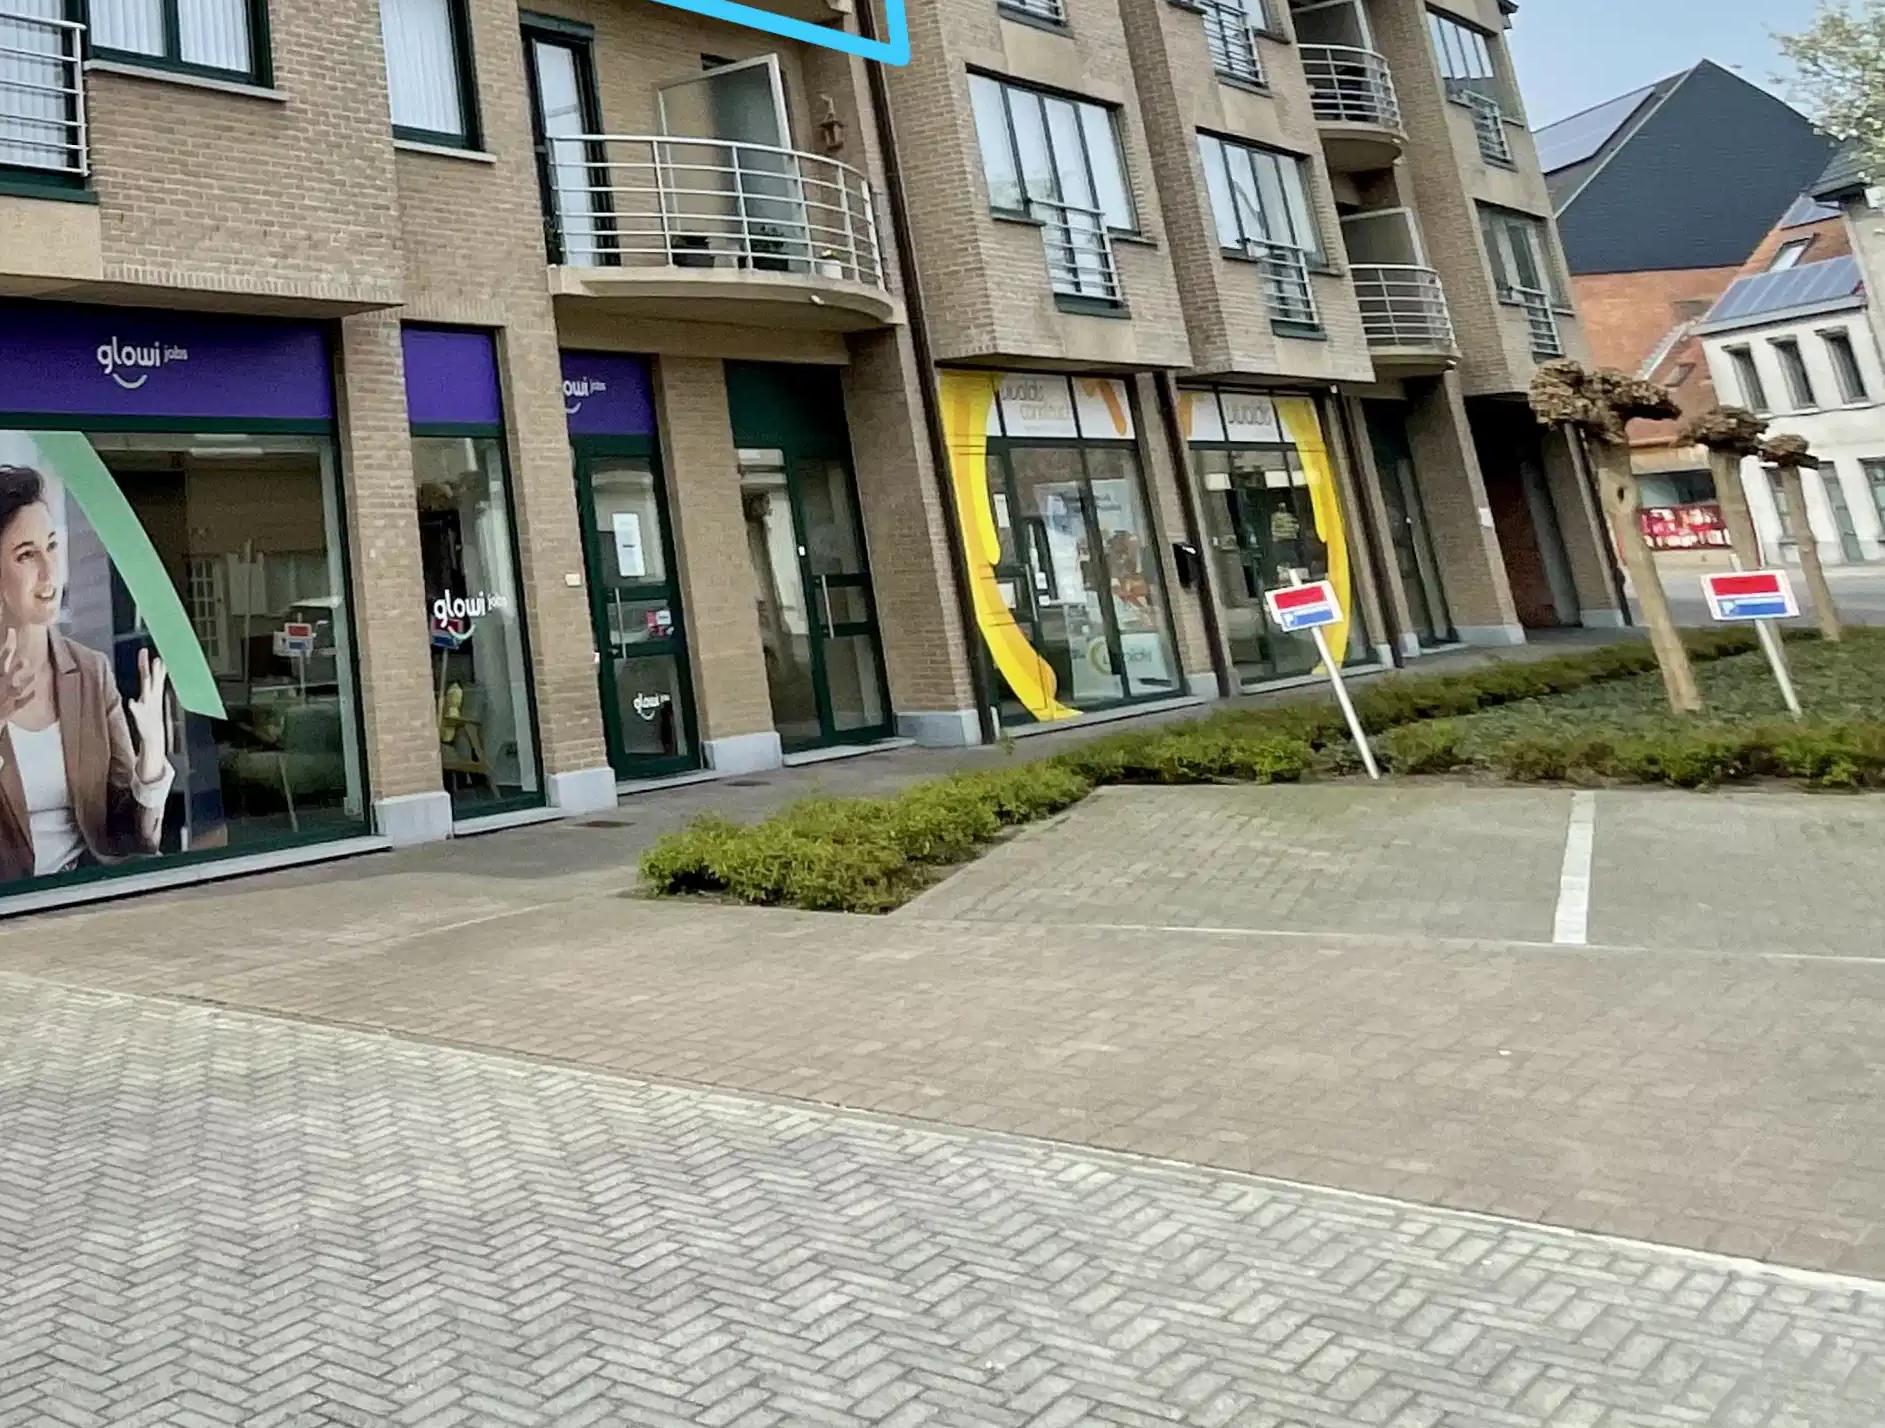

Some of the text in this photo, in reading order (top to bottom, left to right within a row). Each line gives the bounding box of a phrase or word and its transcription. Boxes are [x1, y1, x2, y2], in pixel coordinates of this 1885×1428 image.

[97, 335, 161, 374] glowi
[563, 376, 589, 397] owi
[434, 589, 486, 628] glowi
